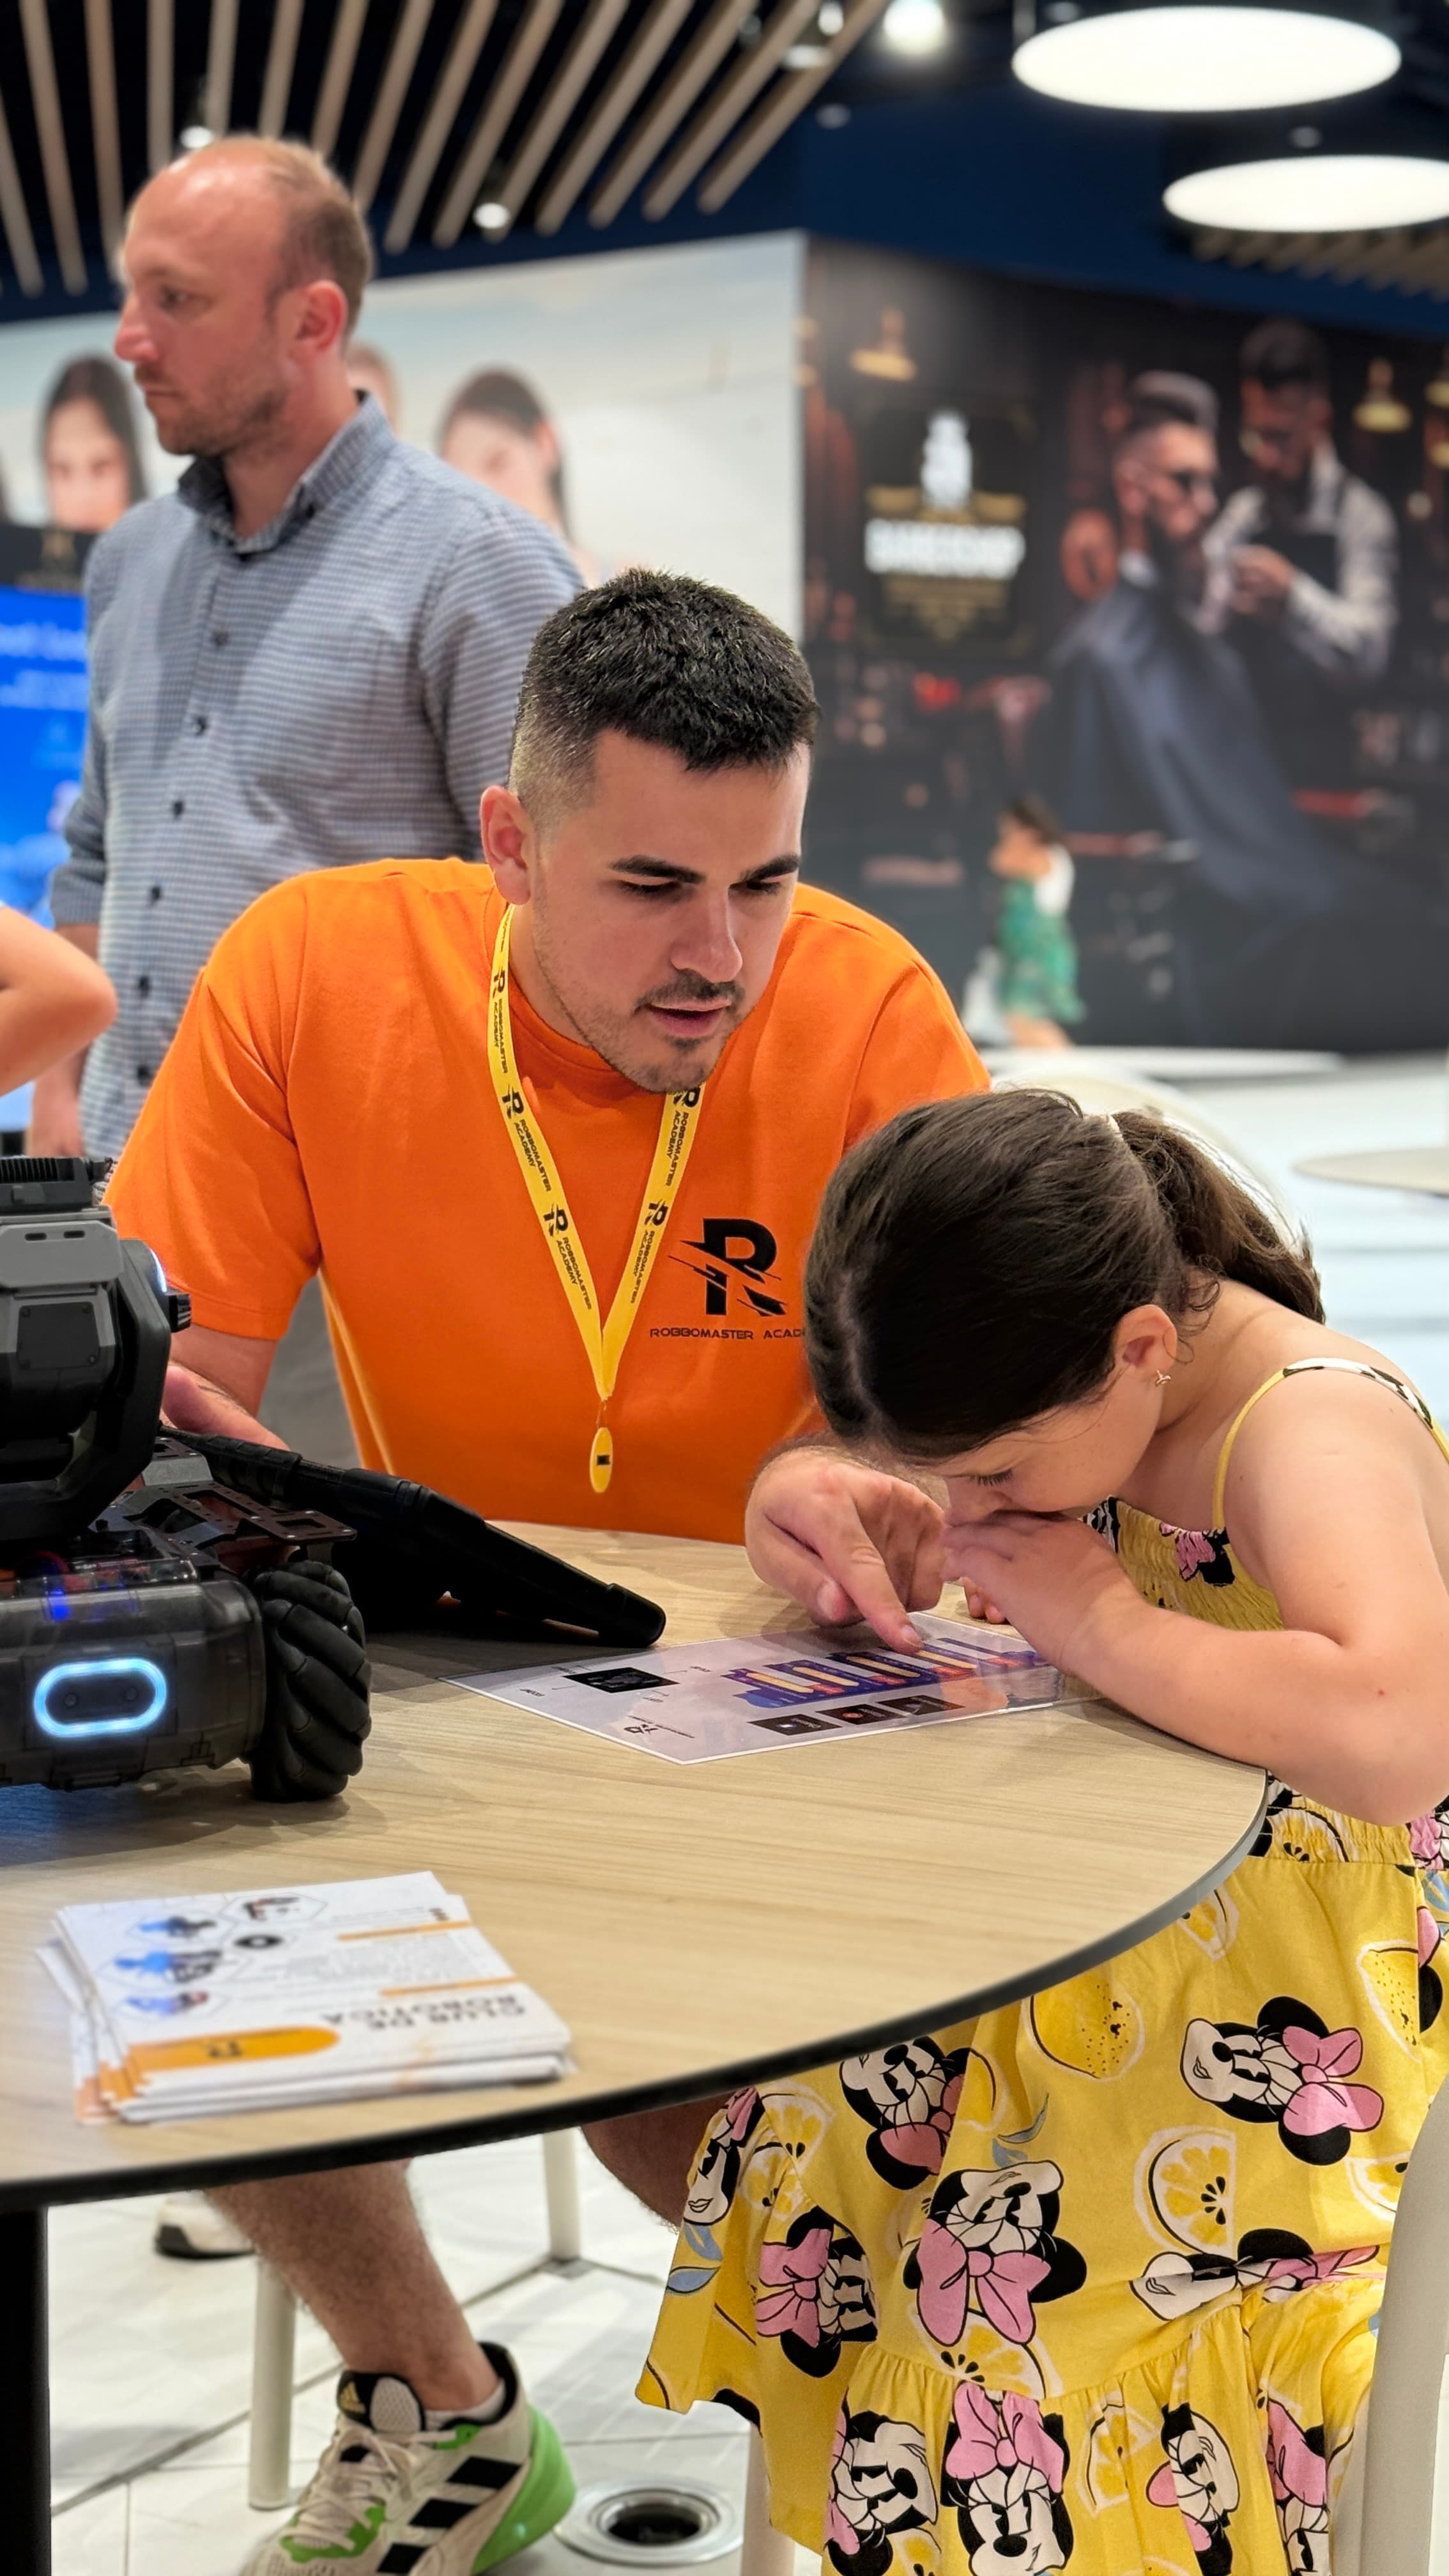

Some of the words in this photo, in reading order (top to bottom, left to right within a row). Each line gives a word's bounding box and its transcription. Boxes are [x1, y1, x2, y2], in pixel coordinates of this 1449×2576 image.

[514, 1122, 536, 1167] ACADEMY
[519, 1119, 552, 1192] ROBBOMASTER
[666, 1110, 681, 1160] ACADEMY
[666, 1112, 689, 1187] ROBBOMASTER
[556, 1239, 578, 1286] ACADEMY
[562, 1236, 592, 1310] ROBBOMASTER
[650, 1328, 754, 1340] ROBBOMASTER
[763, 1328, 806, 1340] ACAD
[365, 2016, 417, 2030] DE
[428, 2004, 526, 2023] CLUB
